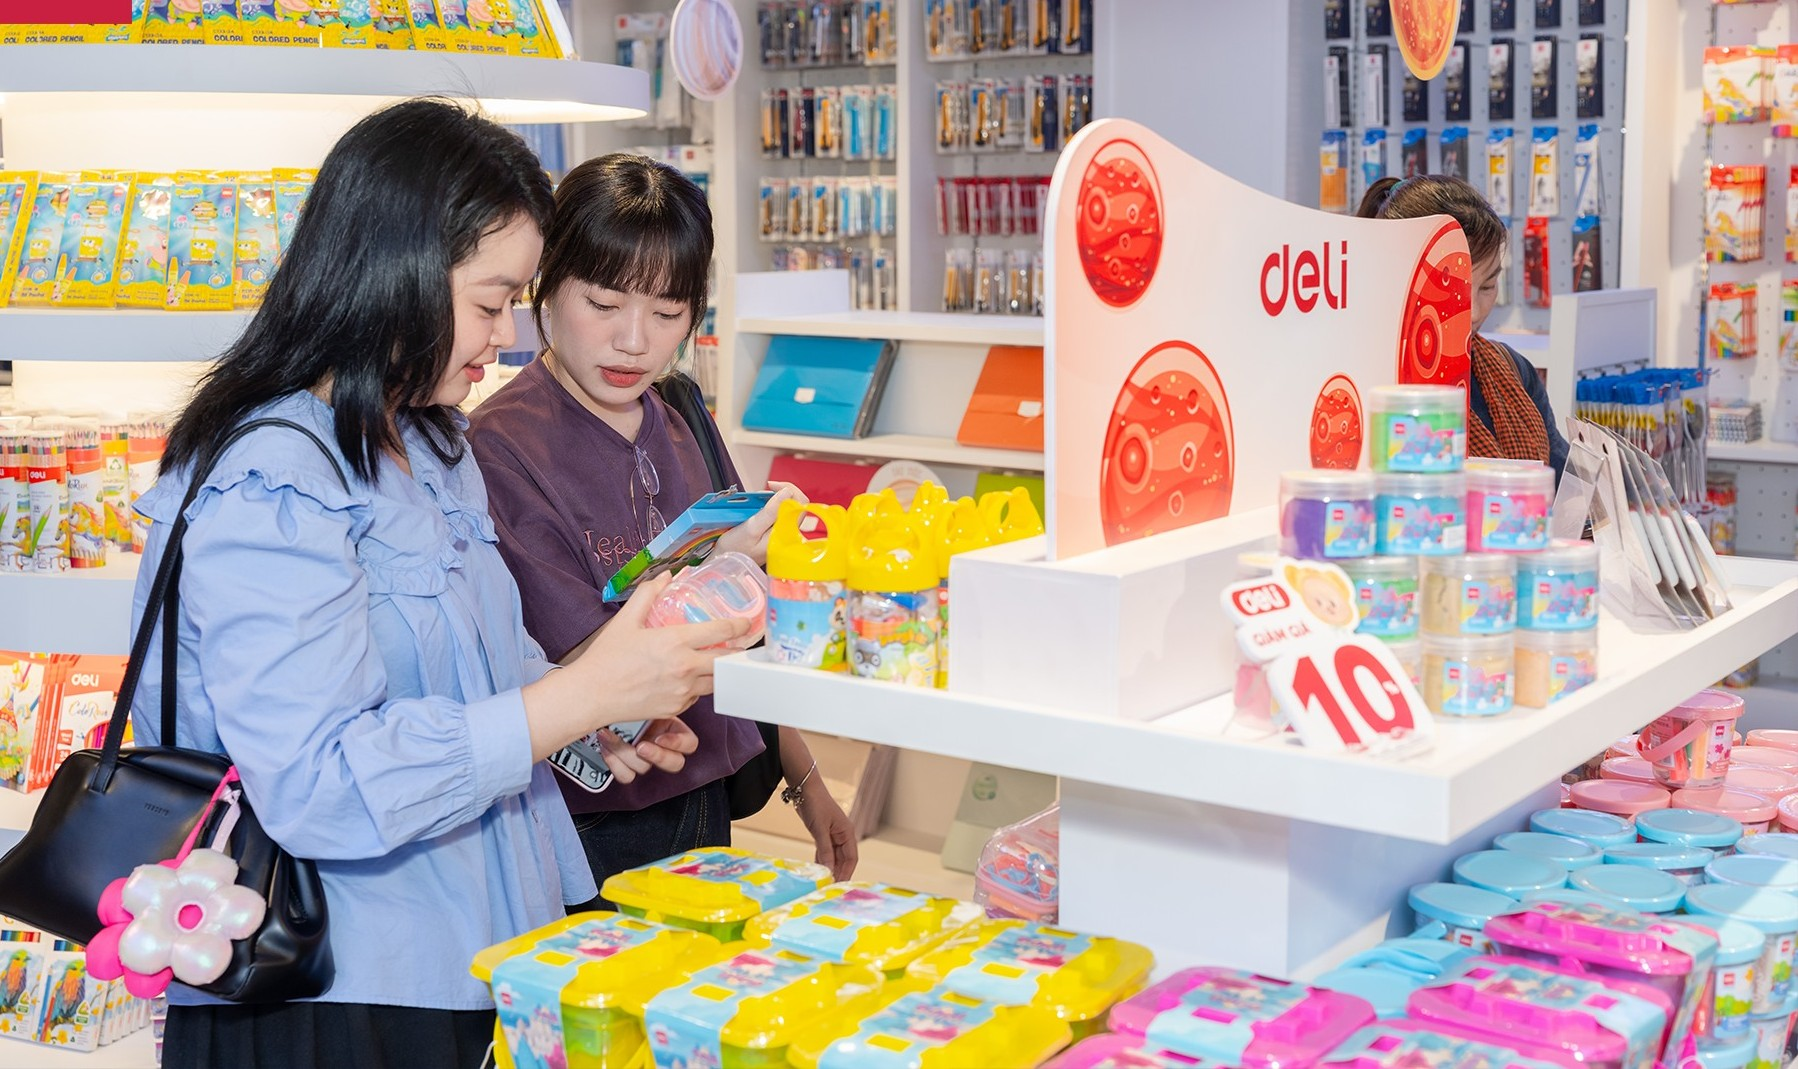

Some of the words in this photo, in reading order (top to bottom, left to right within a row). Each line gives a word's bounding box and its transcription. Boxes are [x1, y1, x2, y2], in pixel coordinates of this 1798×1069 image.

[253, 36, 290, 44] COLORED
[293, 36, 320, 45] PENCIL
[1260, 240, 1348, 317] deli
[1238, 584, 1288, 615] deli
[71, 673, 99, 688] deli
